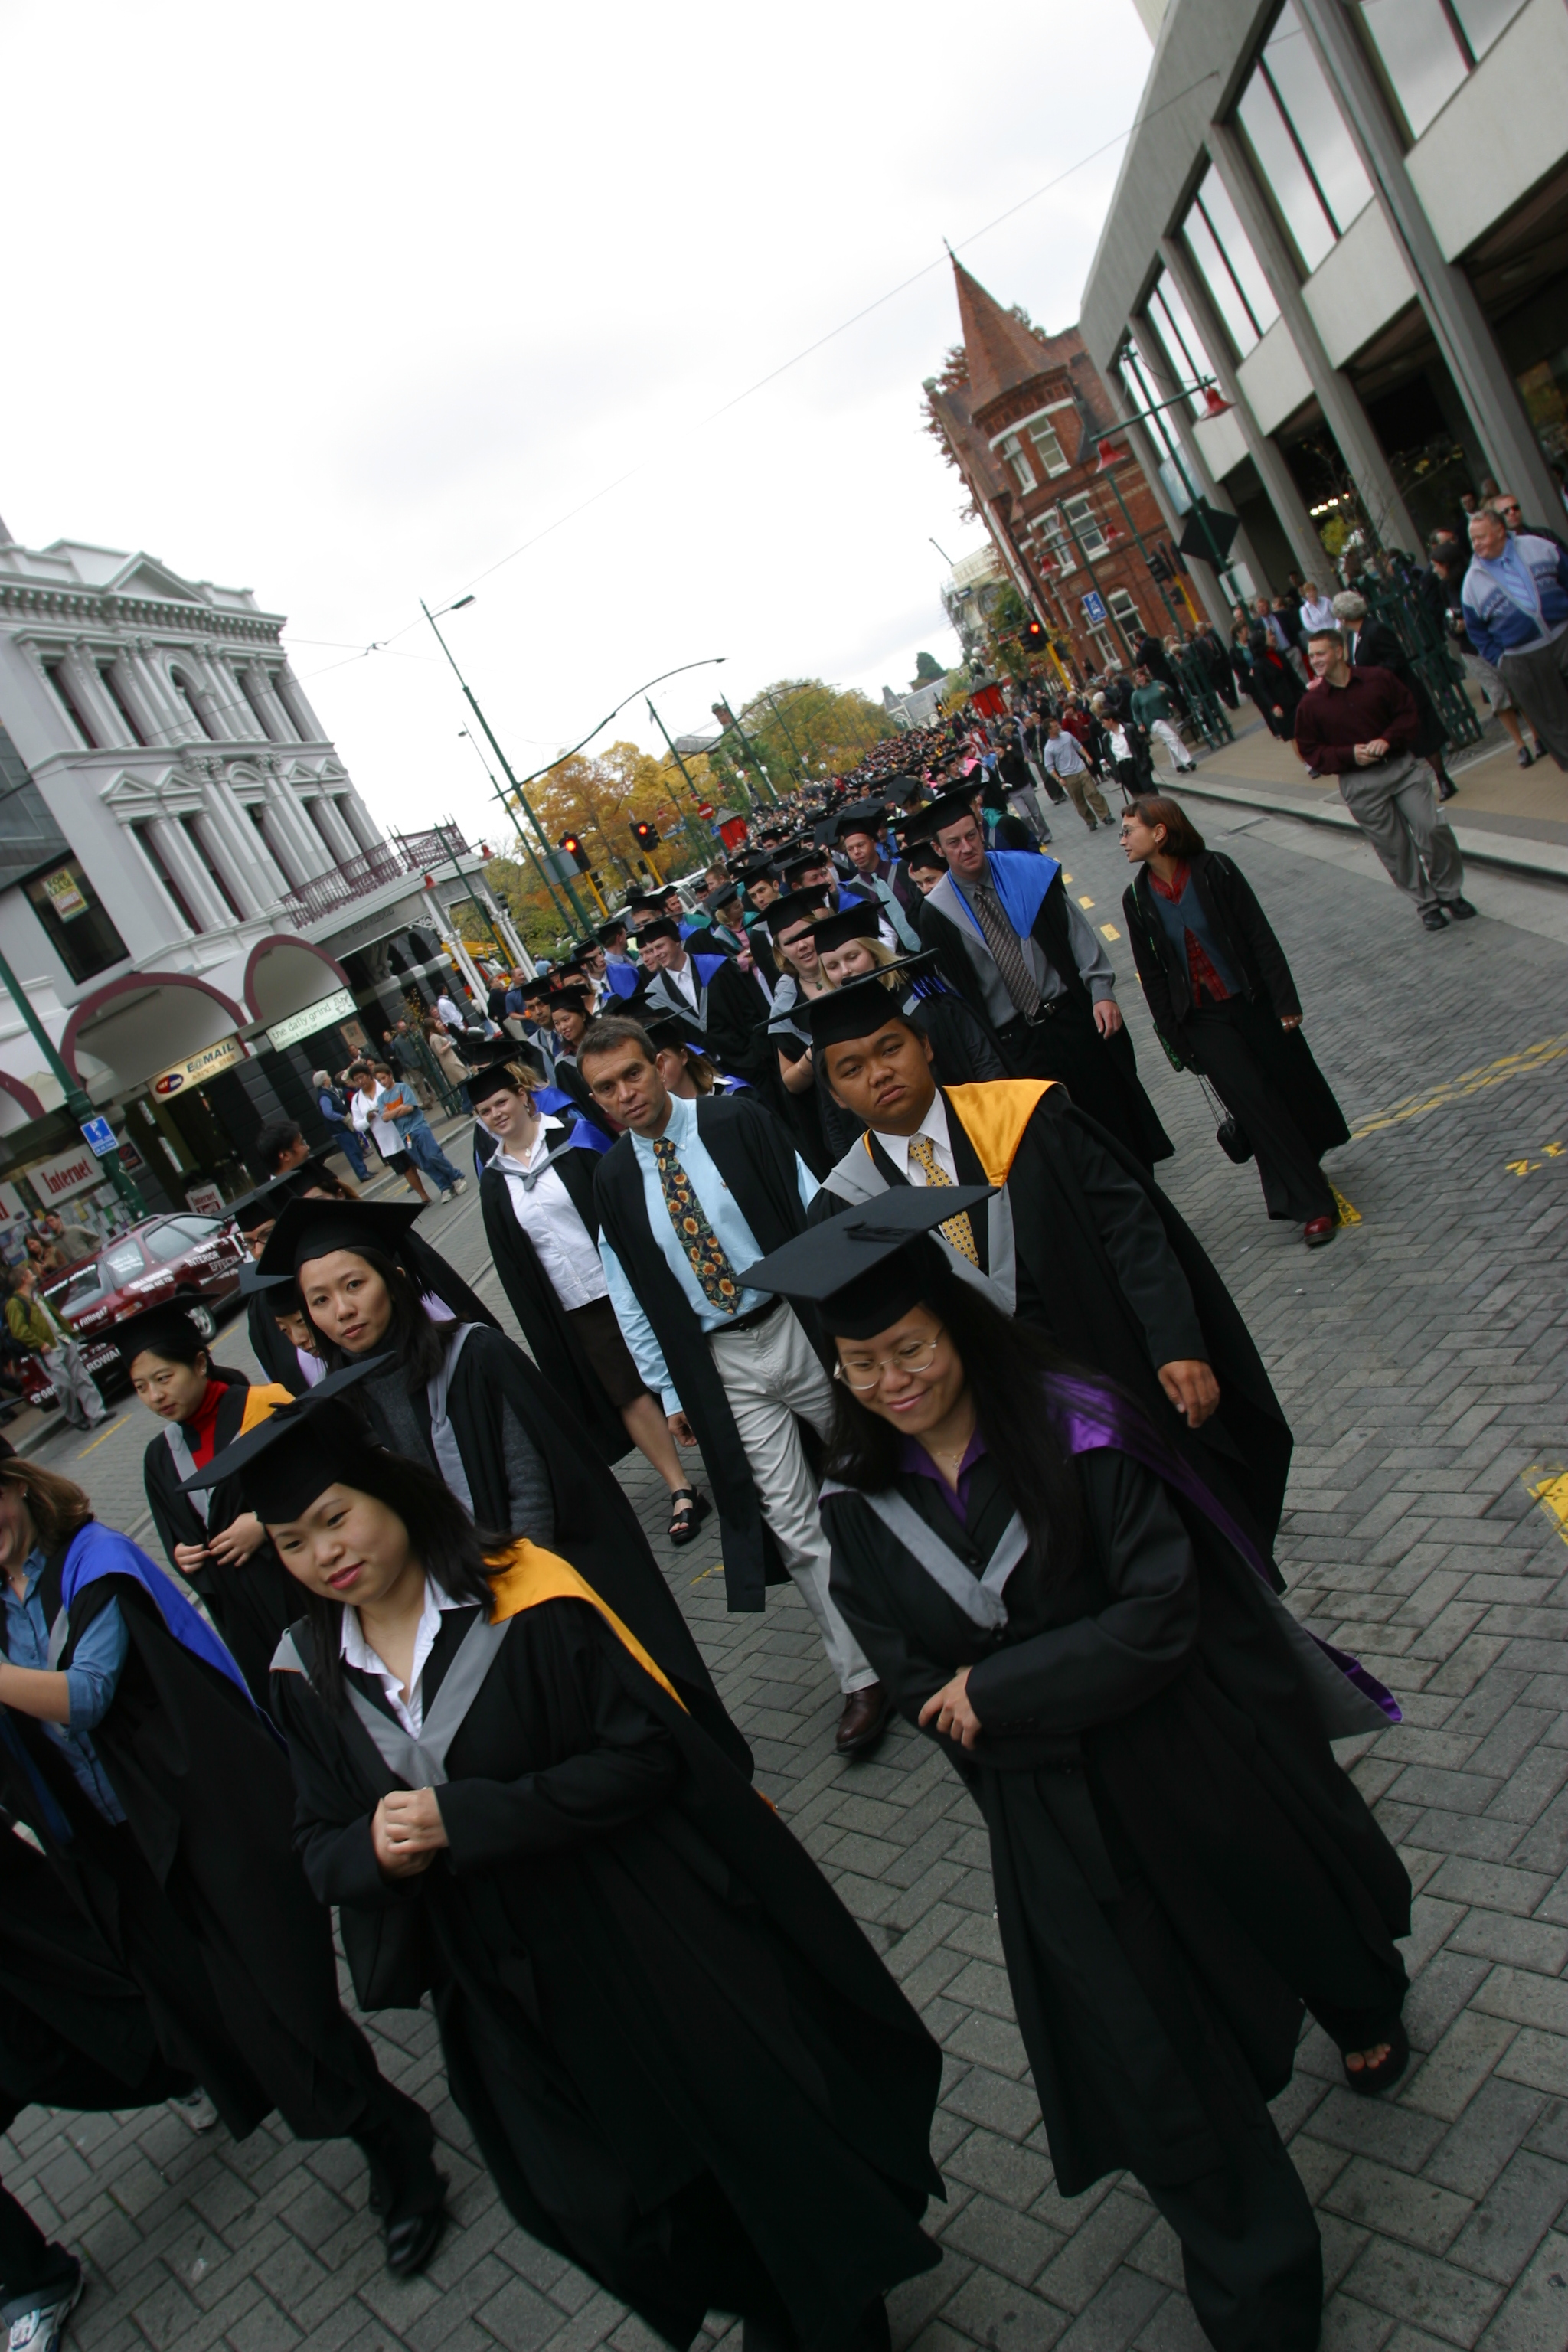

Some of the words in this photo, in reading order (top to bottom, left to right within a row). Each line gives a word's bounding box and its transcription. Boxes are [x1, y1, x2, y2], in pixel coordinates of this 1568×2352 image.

[47, 873, 64, 887] FOR
[48, 879, 74, 897] LEASE
[272, 1027, 286, 1040] the
[288, 1016, 308, 1032] daily
[309, 1003, 331, 1022] grind
[186, 1043, 234, 1073] E@MAIL
[40, 1156, 93, 1194] Internet
[184, 1250, 220, 1267] INTERIOR
[79, 1305, 107, 1328] Fittings?
